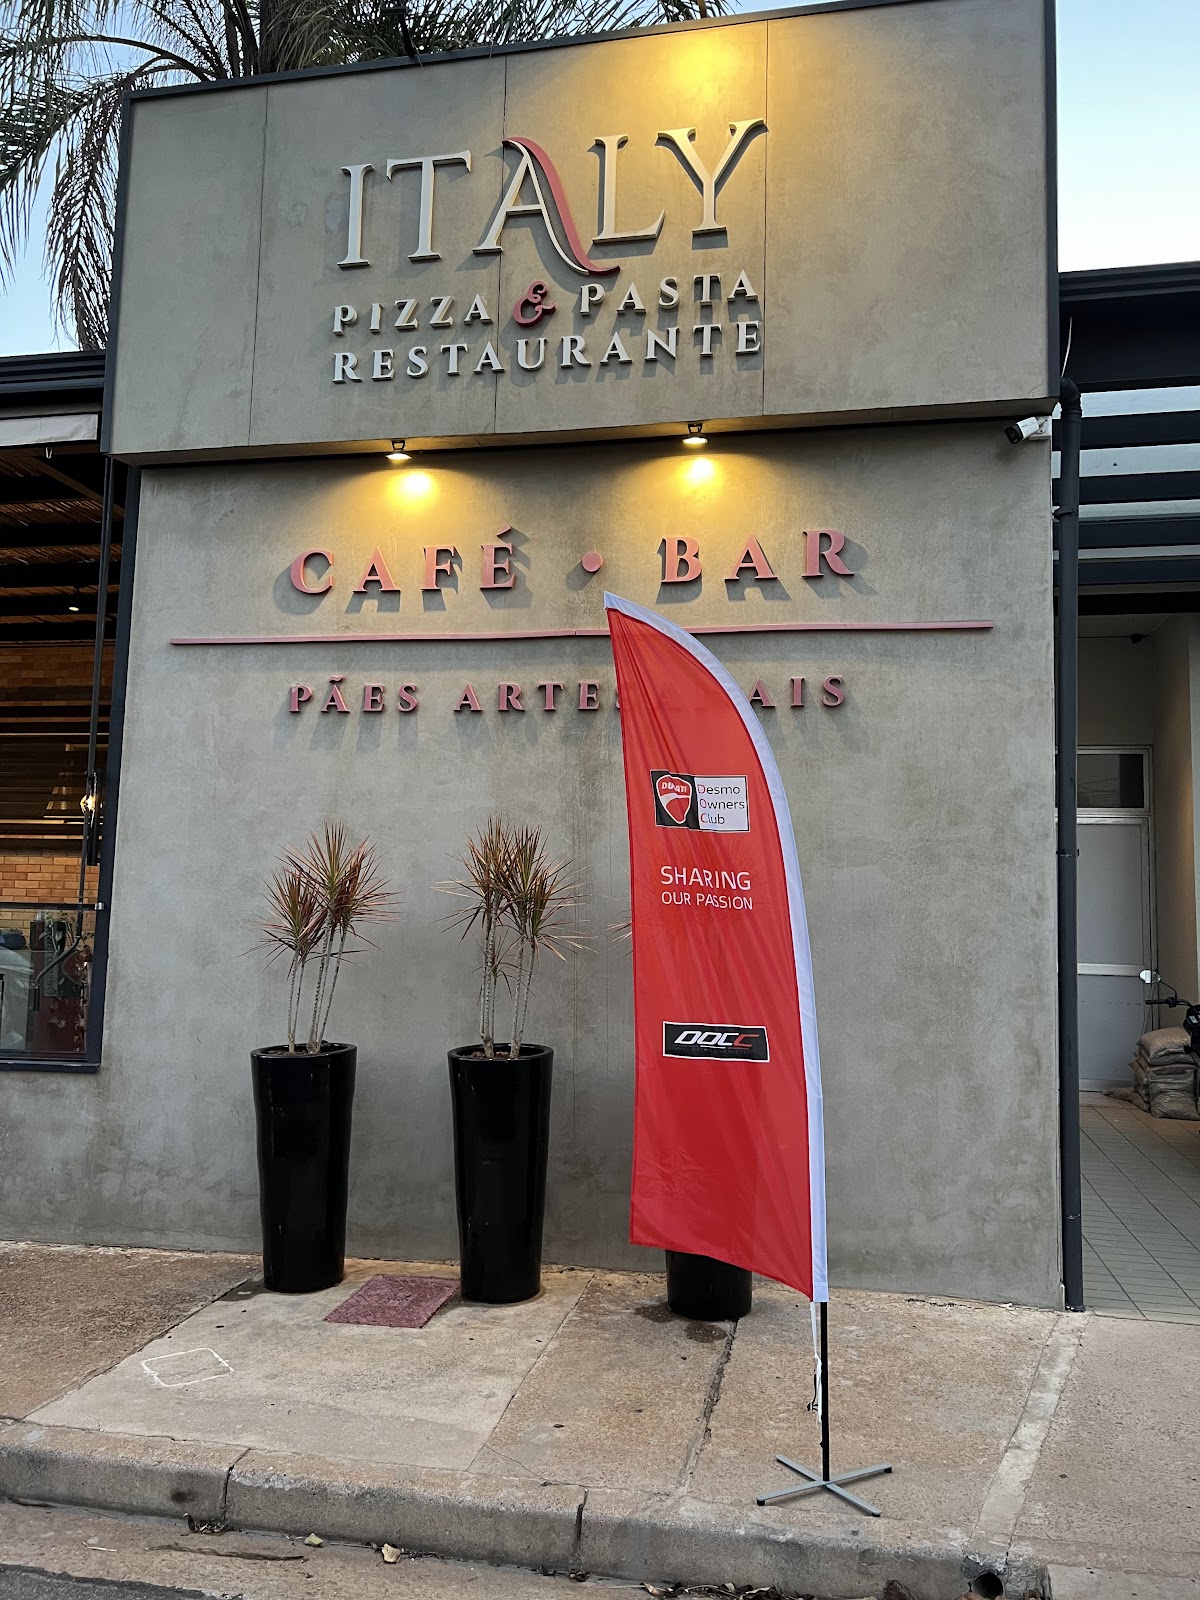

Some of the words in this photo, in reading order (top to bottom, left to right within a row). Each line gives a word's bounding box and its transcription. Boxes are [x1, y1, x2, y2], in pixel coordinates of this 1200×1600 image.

[336, 118, 766, 274] ITALY
[332, 293, 494, 335] PIZZA
[513, 280, 556, 327] &
[580, 270, 759, 316] PASTA
[332, 320, 763, 384] RESTAURANTE
[290, 523, 517, 594] CAFÉ
[661, 529, 855, 583] BAR
[289, 674, 419, 713] PÃES
[453, 674, 846, 712] ARTEAIS
[661, 782, 687, 793] DUATI
[698, 784, 741, 795] Desmo
[700, 798, 745, 810] Owners
[700, 812, 726, 825] Club
[660, 865, 752, 891] SHARING
[661, 891, 692, 906] OUR
[696, 893, 753, 910] PASSION
